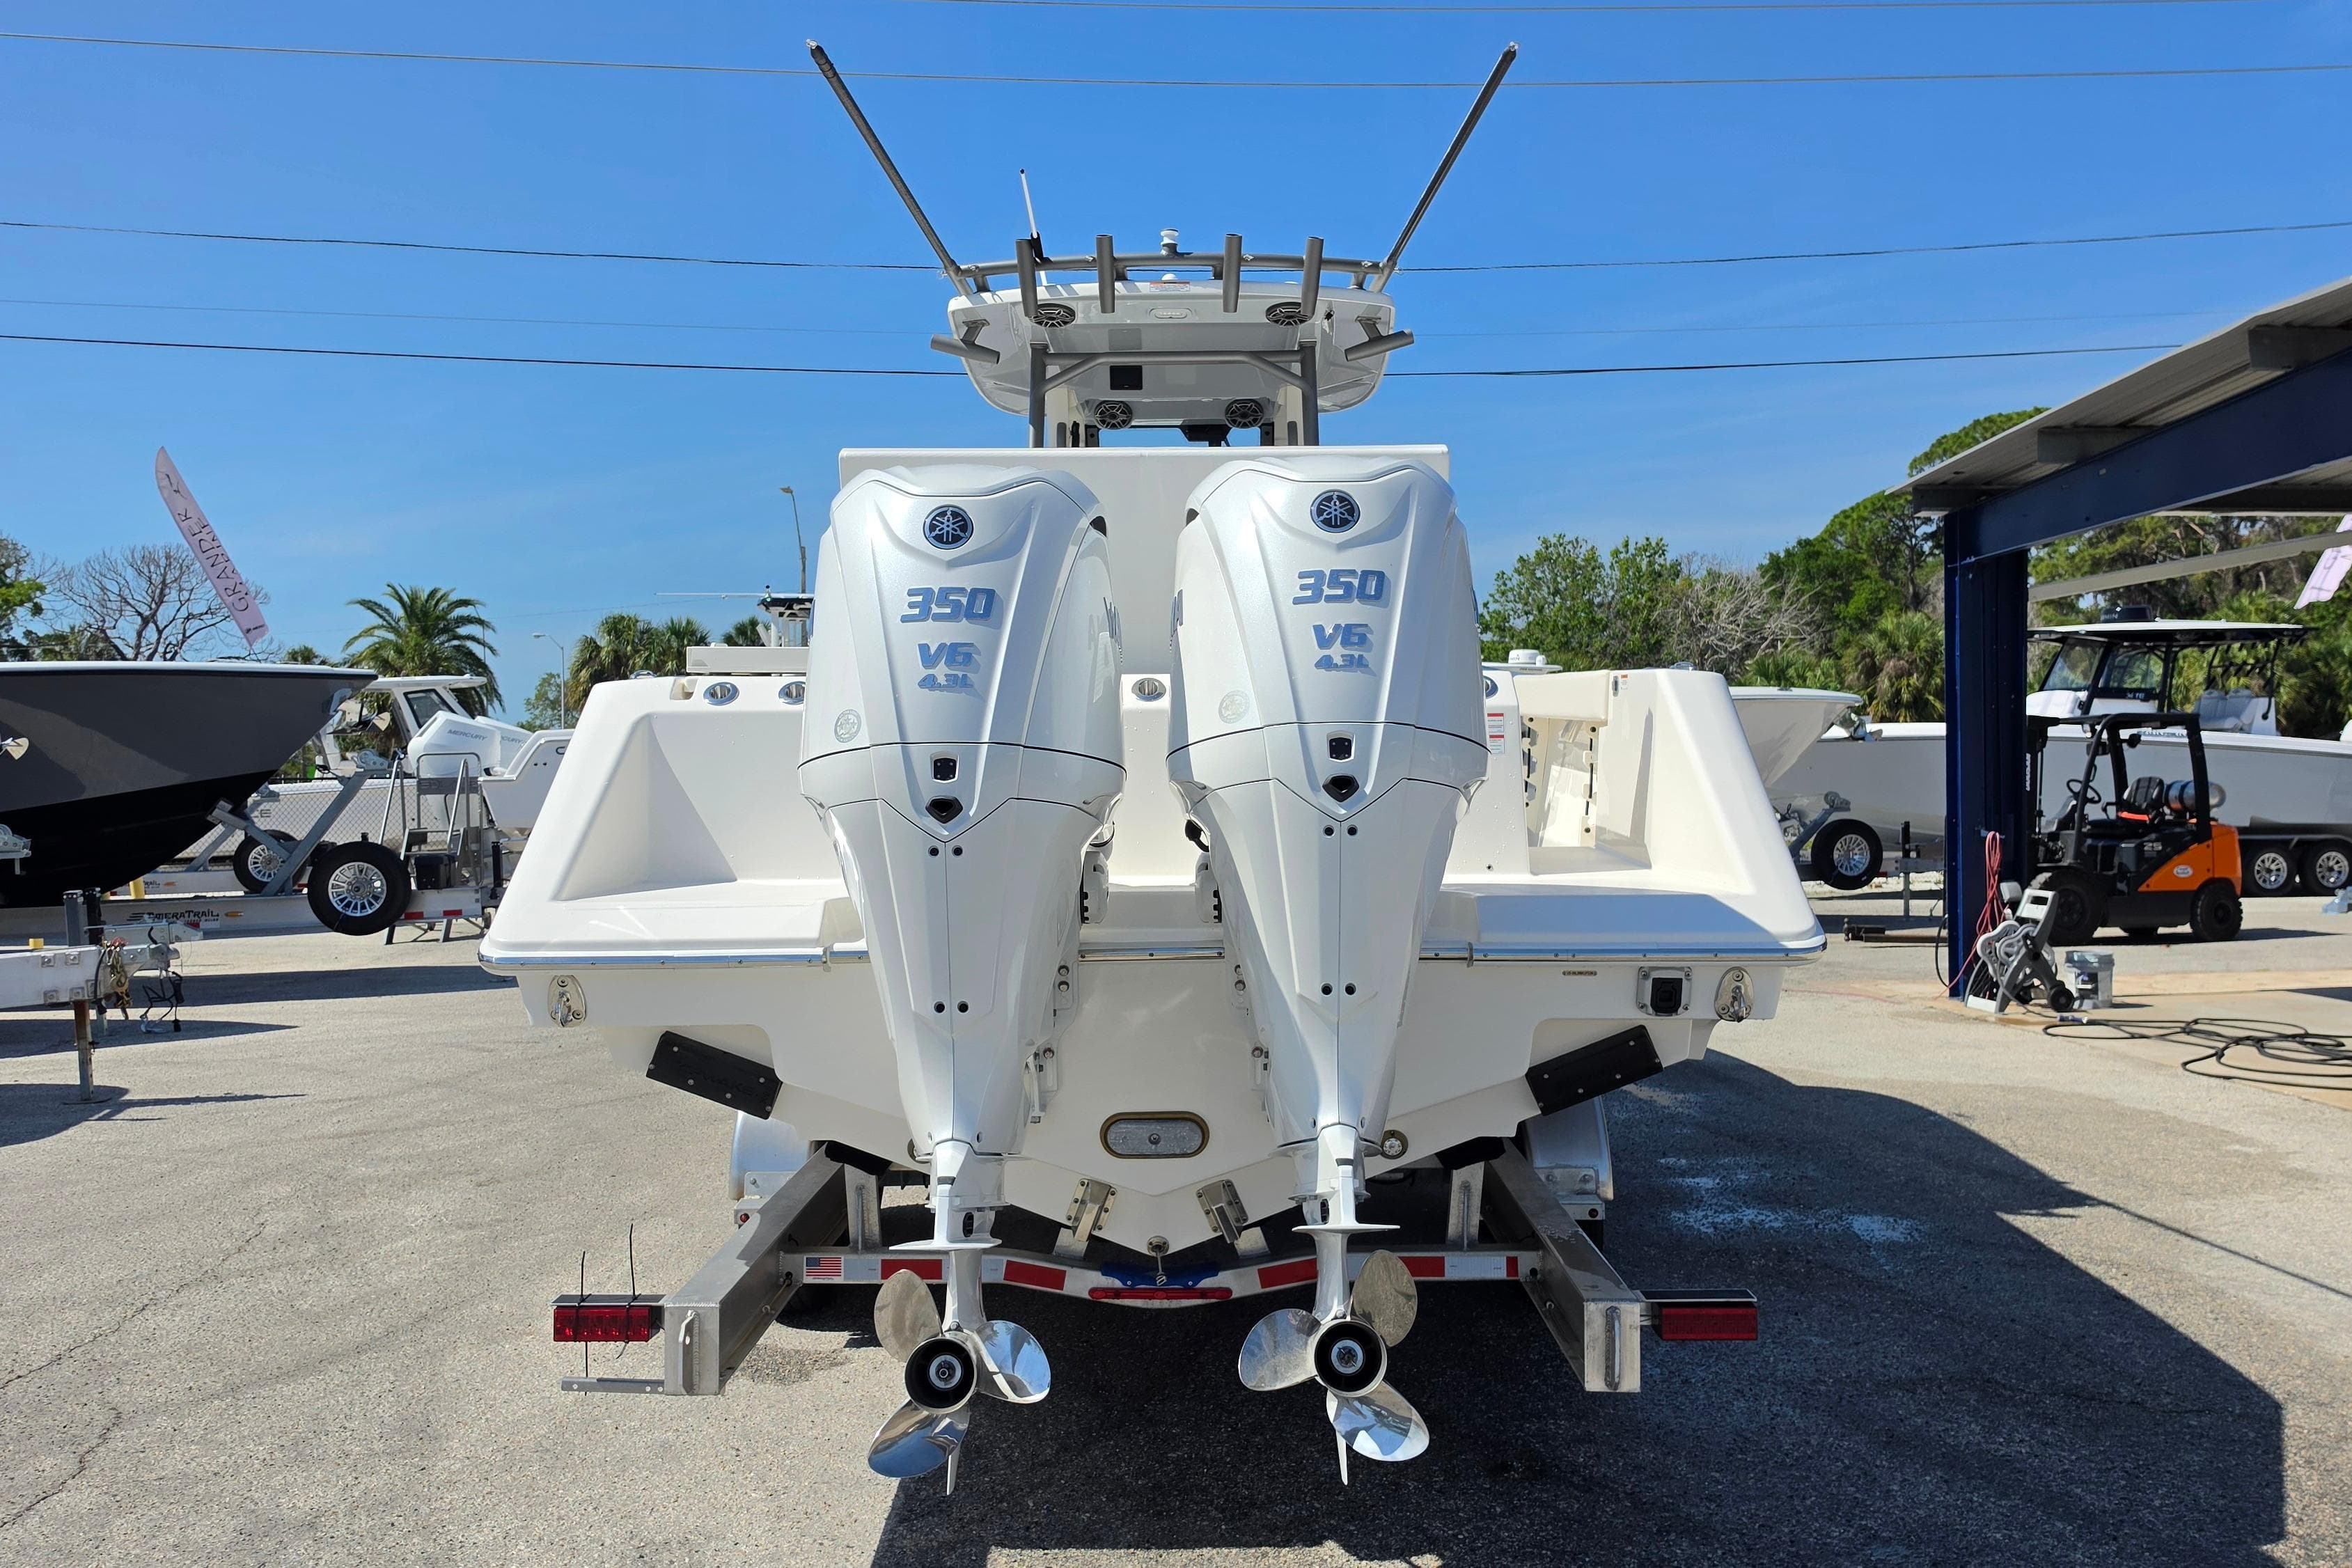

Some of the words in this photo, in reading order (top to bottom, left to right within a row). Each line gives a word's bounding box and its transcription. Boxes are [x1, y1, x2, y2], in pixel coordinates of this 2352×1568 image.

[178, 508, 249, 612] GRANDER
[1292, 569, 1386, 606] 350
[900, 586, 996, 624] 350
[1312, 623, 1370, 650] V6
[917, 642, 975, 670] V6
[1314, 654, 1370, 669] 4.3L
[917, 673, 975, 689] 4.3L
[447, 729, 488, 741] MERCURY
[501, 735, 524, 744] CURY
[2144, 842, 2163, 851] 25
